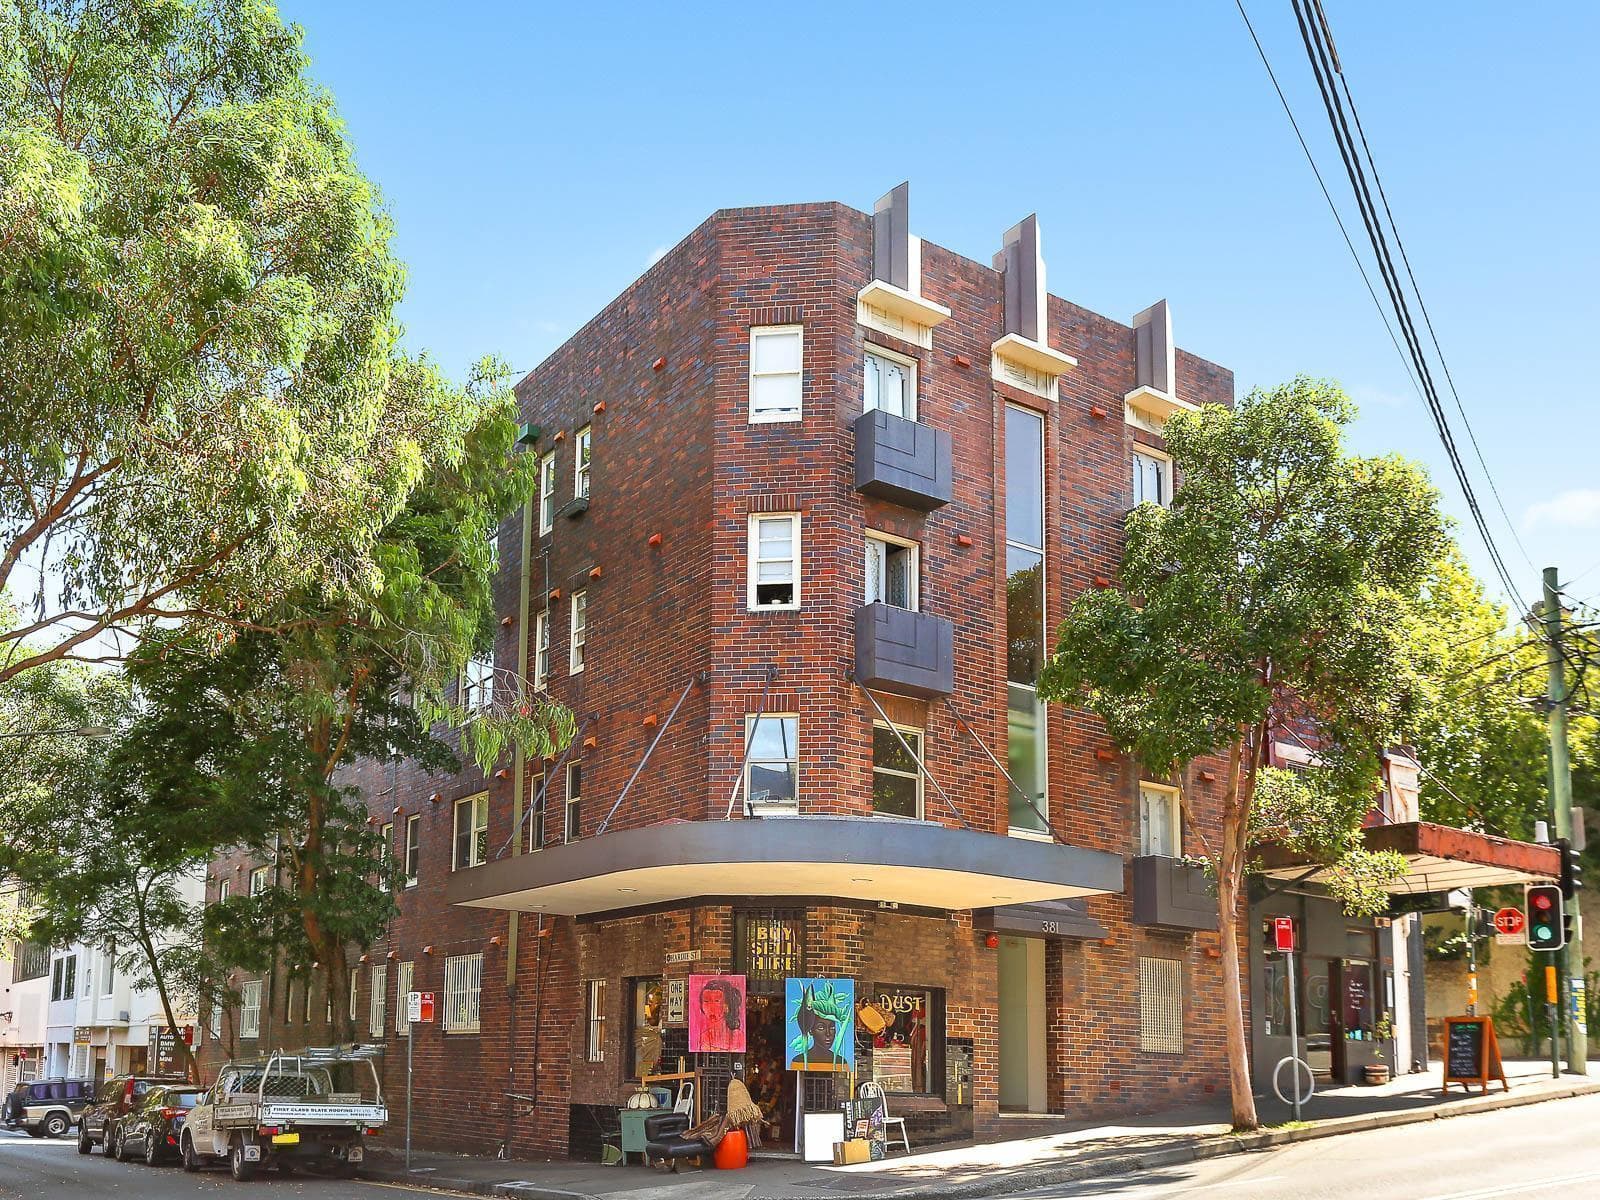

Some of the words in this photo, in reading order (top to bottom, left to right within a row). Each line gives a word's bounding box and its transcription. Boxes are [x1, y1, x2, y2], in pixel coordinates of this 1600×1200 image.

[1042, 920, 1058, 934] 381
[1498, 916, 1521, 926] STOP
[757, 926, 792, 940] BUY
[751, 942, 797, 955] SELL
[690, 951, 697, 960] ST
[752, 956, 796, 970] HIRE
[670, 983, 682, 993] ONE
[670, 996, 682, 1006] WAY
[879, 992, 923, 1013] DUST
